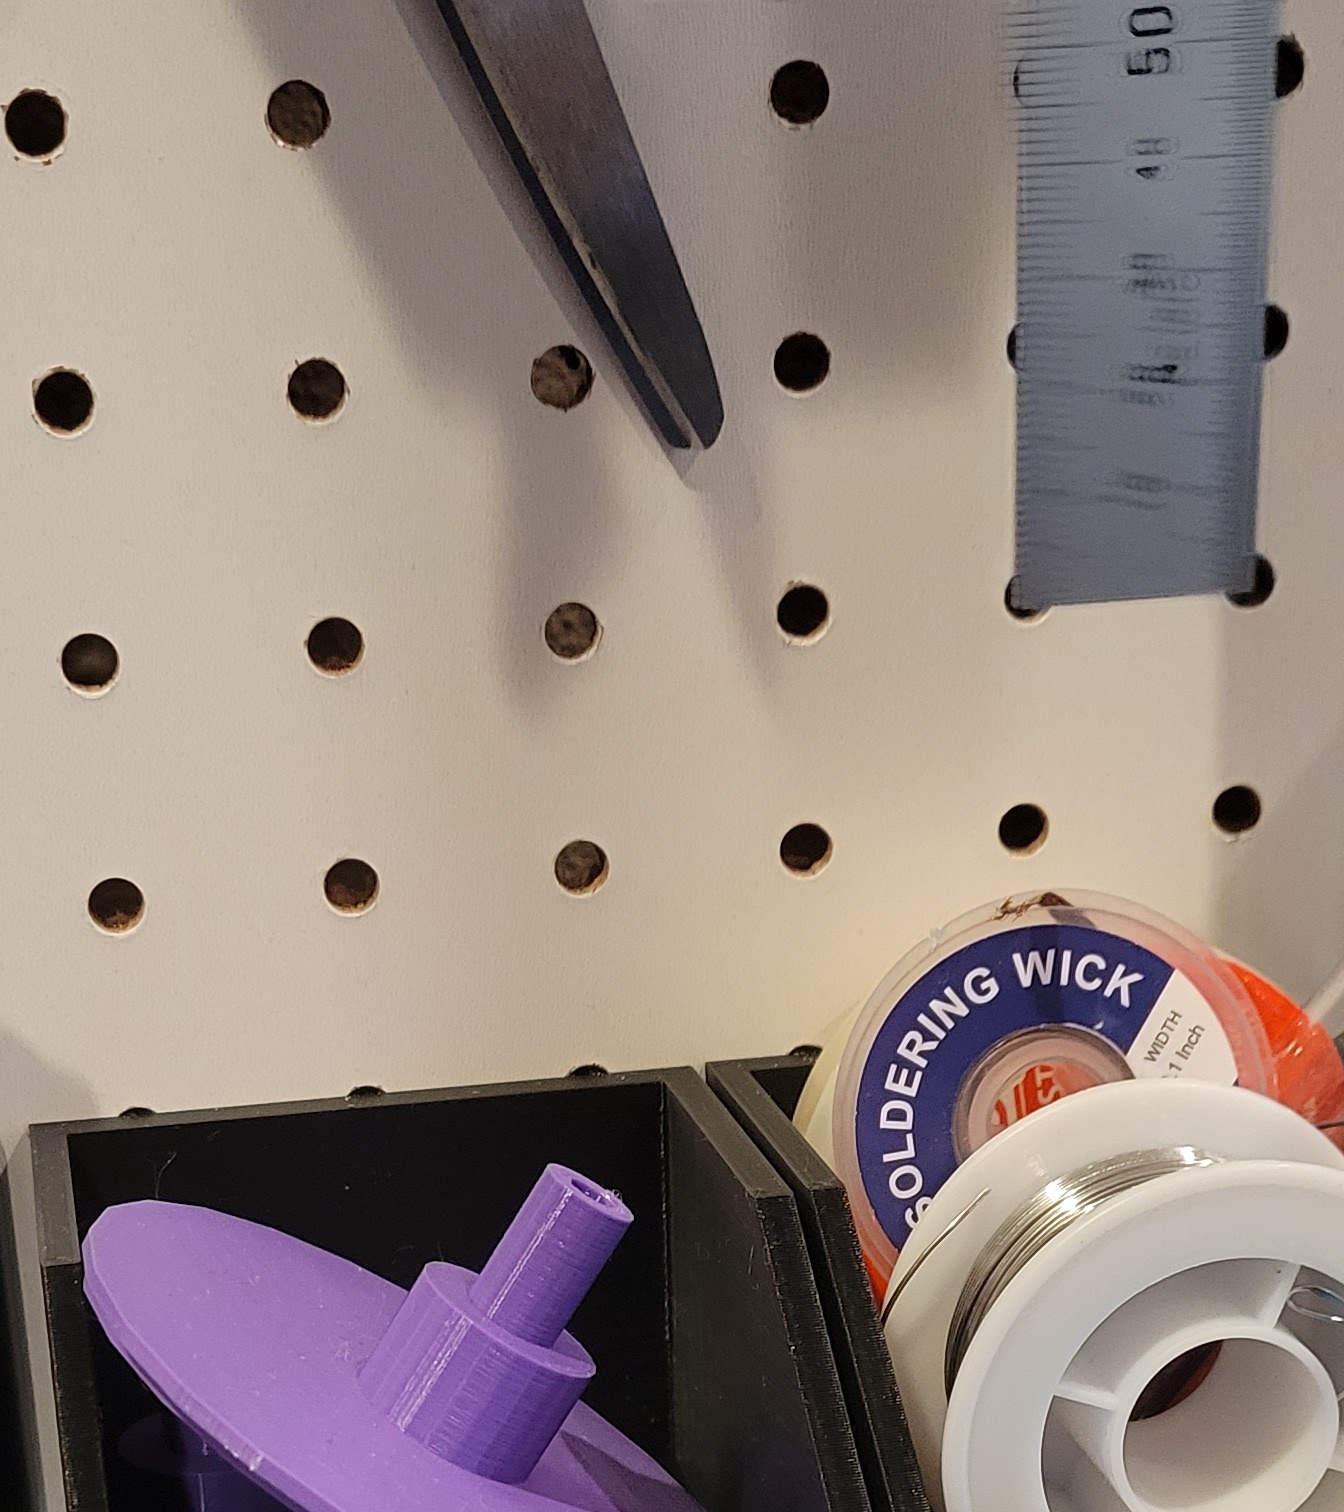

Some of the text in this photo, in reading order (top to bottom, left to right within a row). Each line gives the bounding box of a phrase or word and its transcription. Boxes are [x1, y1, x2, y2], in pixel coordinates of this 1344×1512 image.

[1012, 948, 1146, 1009] WICK
[1144, 1010, 1182, 1062] WIDTH
[1175, 1025, 1205, 1060] Inch
